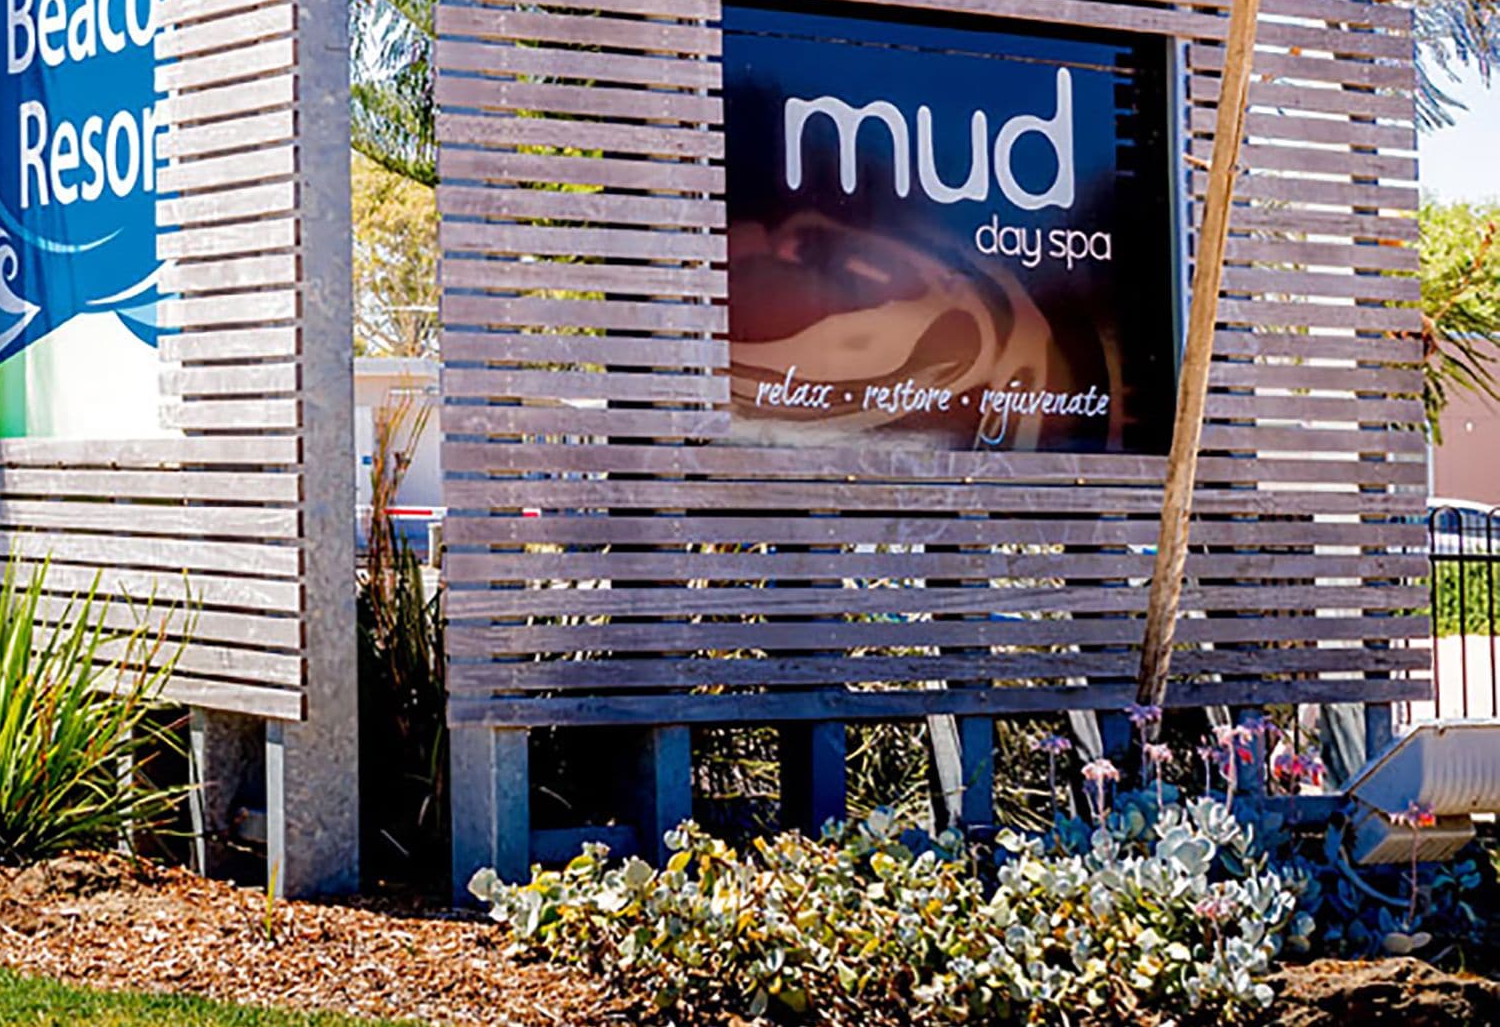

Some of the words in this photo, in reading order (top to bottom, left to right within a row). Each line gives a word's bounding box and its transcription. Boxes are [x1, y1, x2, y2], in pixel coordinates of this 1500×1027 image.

[19, 91, 179, 209] Resor
[784, 67, 1075, 210] mud
[975, 214, 1043, 269] day
[1047, 229, 1112, 270] spa
[755, 365, 831, 408] relax
[862, 377, 952, 411] restore
[978, 380, 1110, 445] rejuvenate
